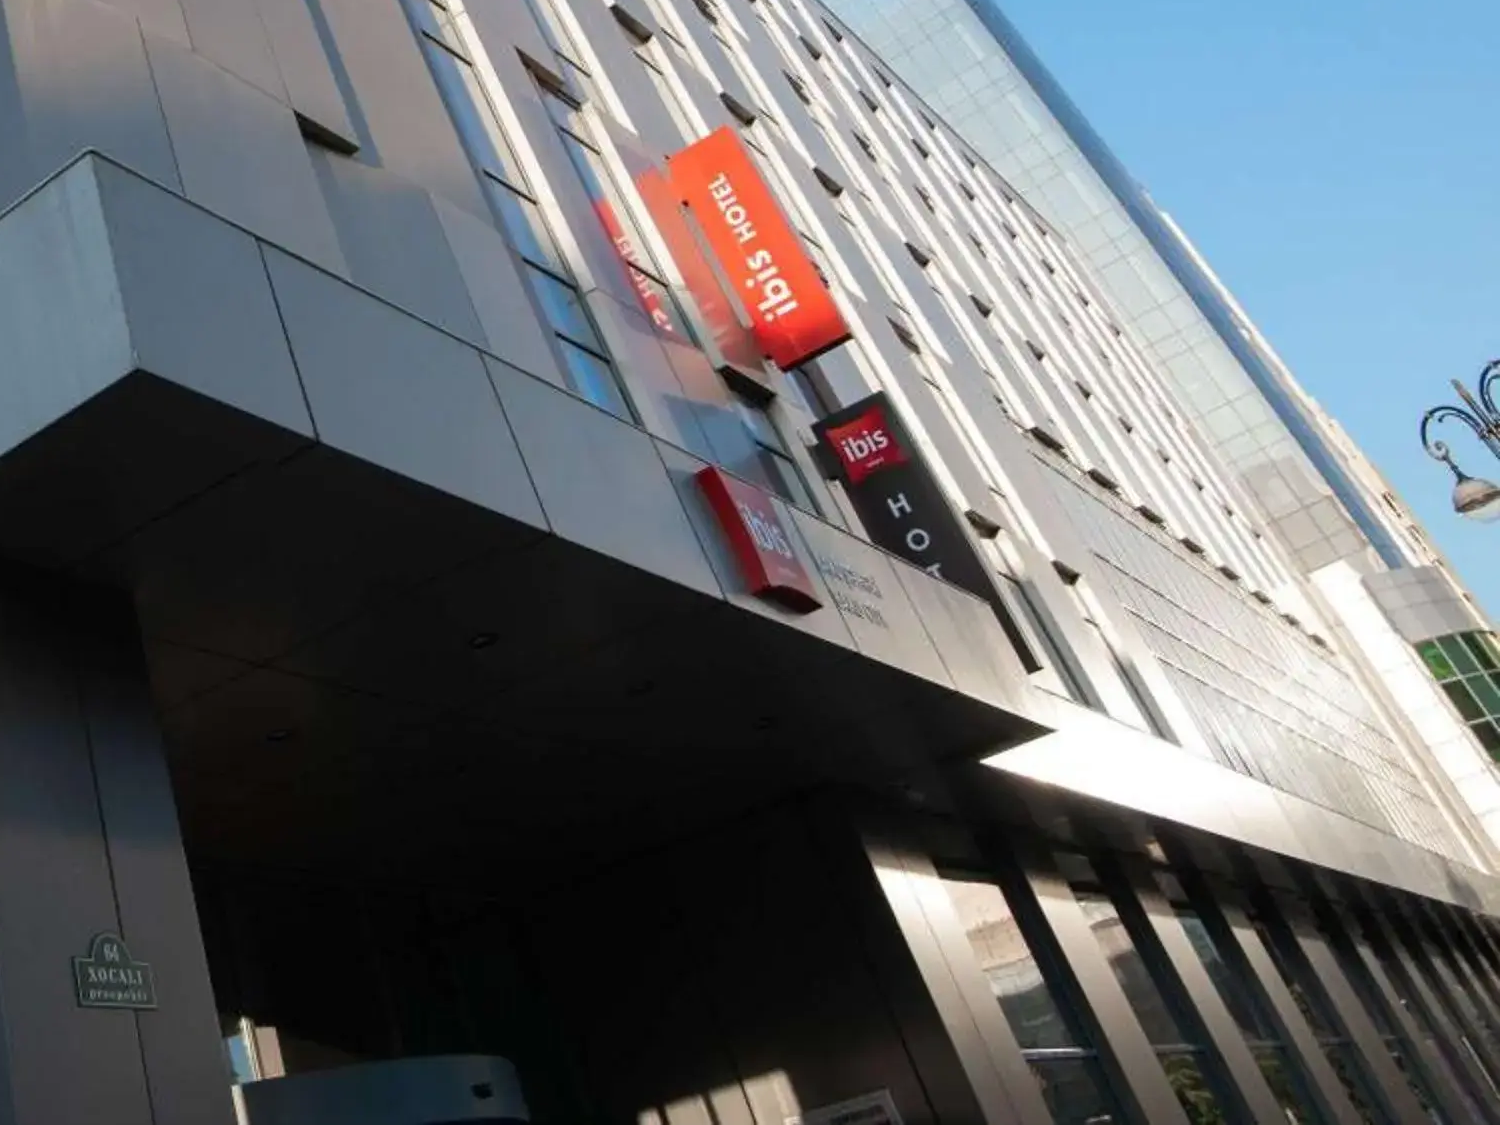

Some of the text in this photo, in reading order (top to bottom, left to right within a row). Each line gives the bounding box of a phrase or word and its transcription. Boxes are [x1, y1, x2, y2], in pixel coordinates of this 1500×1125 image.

[707, 172, 799, 323] ibis HOTEL
[841, 429, 889, 463] ibis
